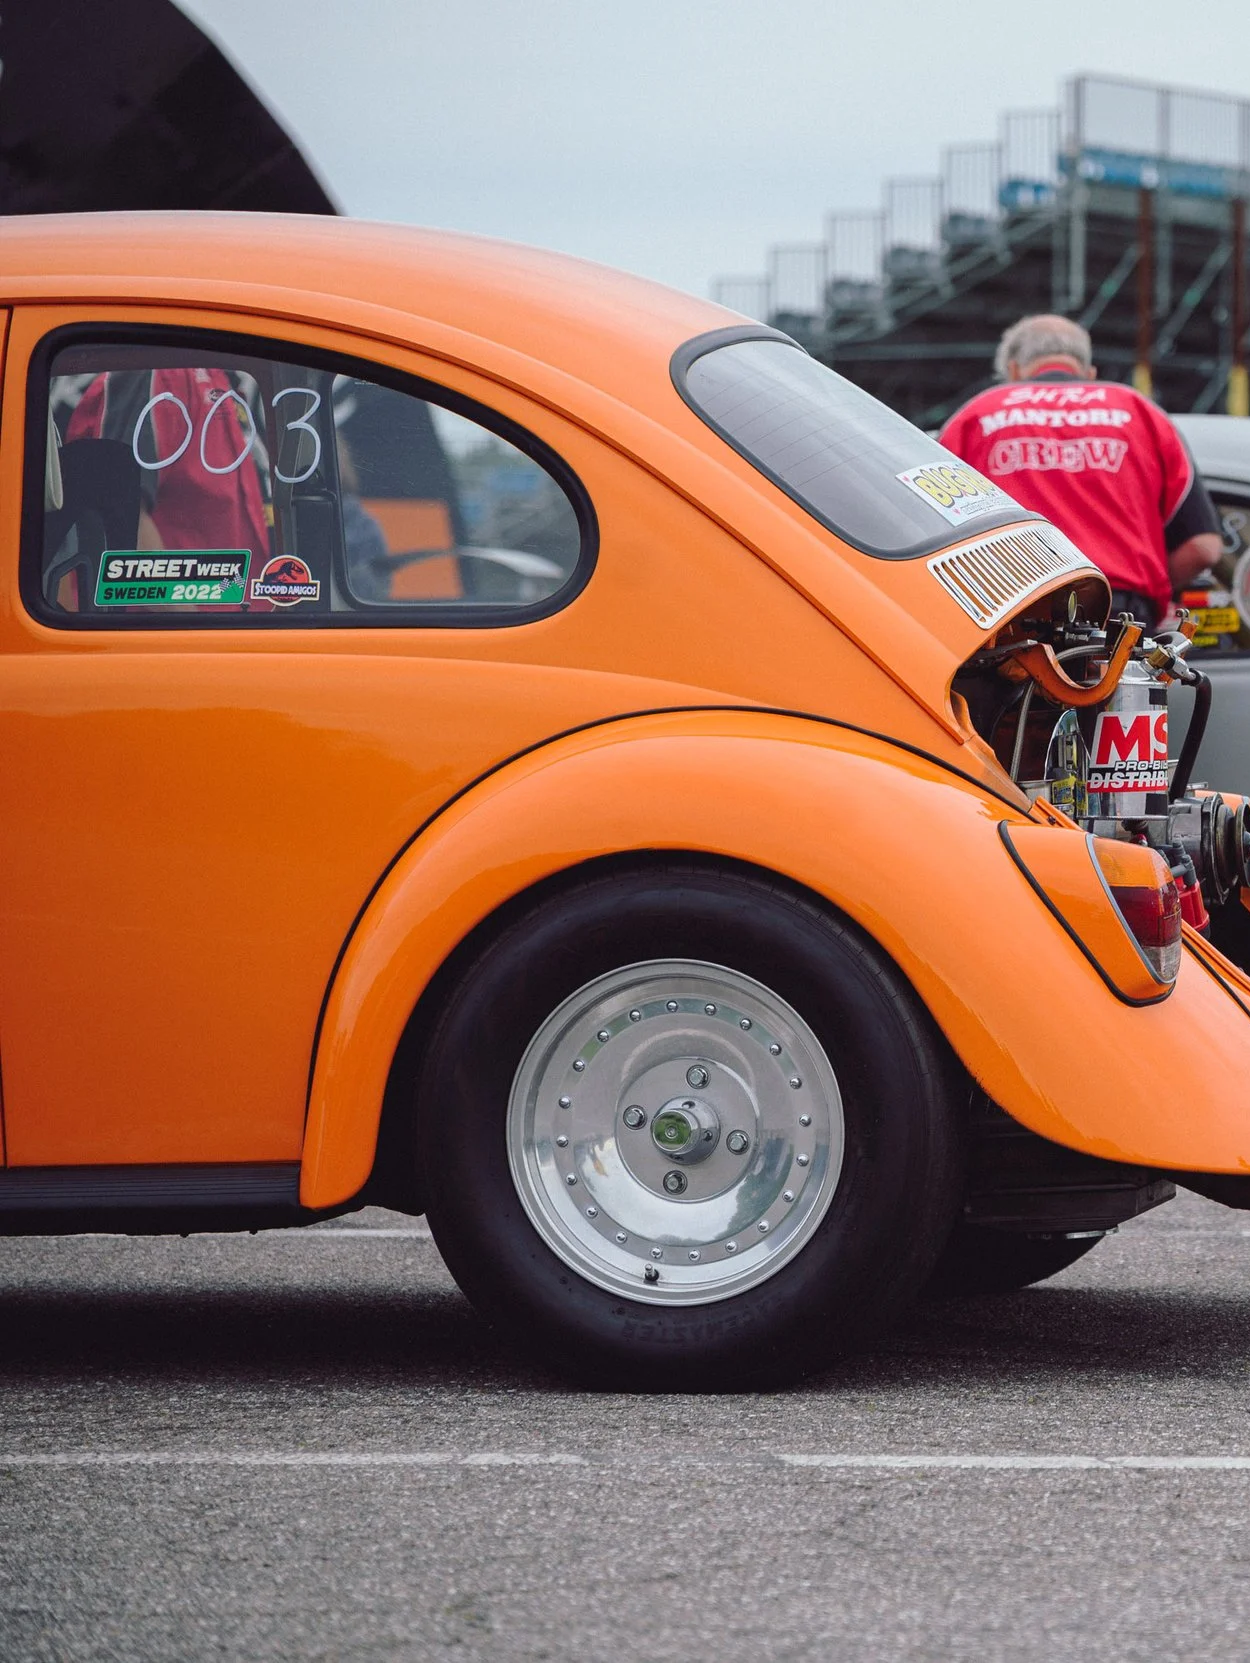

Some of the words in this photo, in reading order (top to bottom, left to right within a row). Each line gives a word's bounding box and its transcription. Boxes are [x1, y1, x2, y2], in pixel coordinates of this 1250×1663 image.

[979, 407, 1132, 437] MANTORP
[133, 387, 322, 484] 003
[987, 436, 1129, 476] CREW
[106, 558, 198, 579] STREET
[197, 562, 242, 577] WEEK
[103, 586, 167, 600] SWEDEN
[170, 583, 222, 600] 2022
[288, 584, 317, 596] AMIGOS
